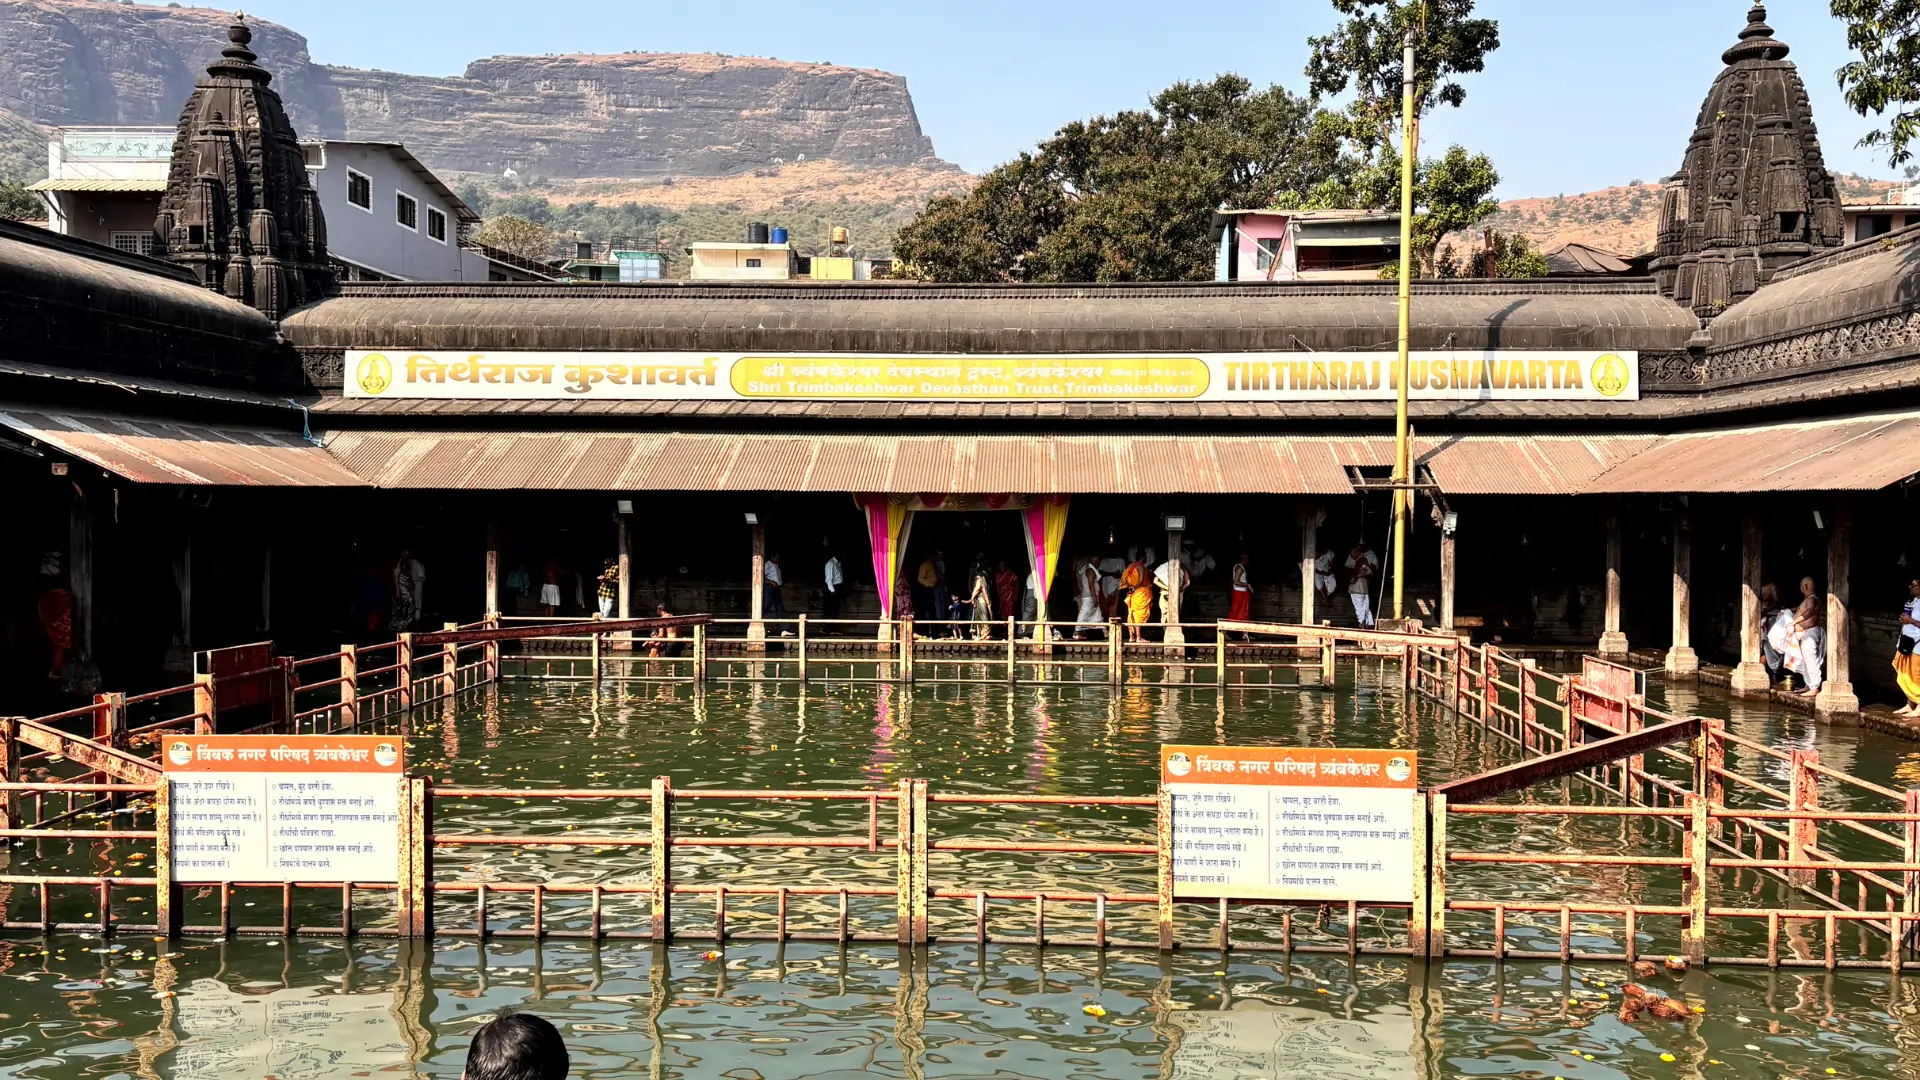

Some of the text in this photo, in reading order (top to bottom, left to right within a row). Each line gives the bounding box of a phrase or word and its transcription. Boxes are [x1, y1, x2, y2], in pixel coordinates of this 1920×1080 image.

[405, 355, 720, 394] तिर्थराज कुशावर्त
[762, 362, 785, 378] श्री
[1223, 360, 1380, 390] TIRTHARAJ
[747, 380, 781, 393] Shri
[786, 381, 917, 394] Trimbakeshwar
[920, 382, 1009, 394] Devasthan
[197, 744, 234, 761] त्रिंबक
[237, 748, 267, 762] नगर
[313, 744, 369, 762] त्र्यंबकेश्वर
[1196, 755, 1236, 773] त्रिंबक
[1239, 759, 1271, 774] नगर
[1320, 757, 1380, 777] त्र्यंबकेश्वर
